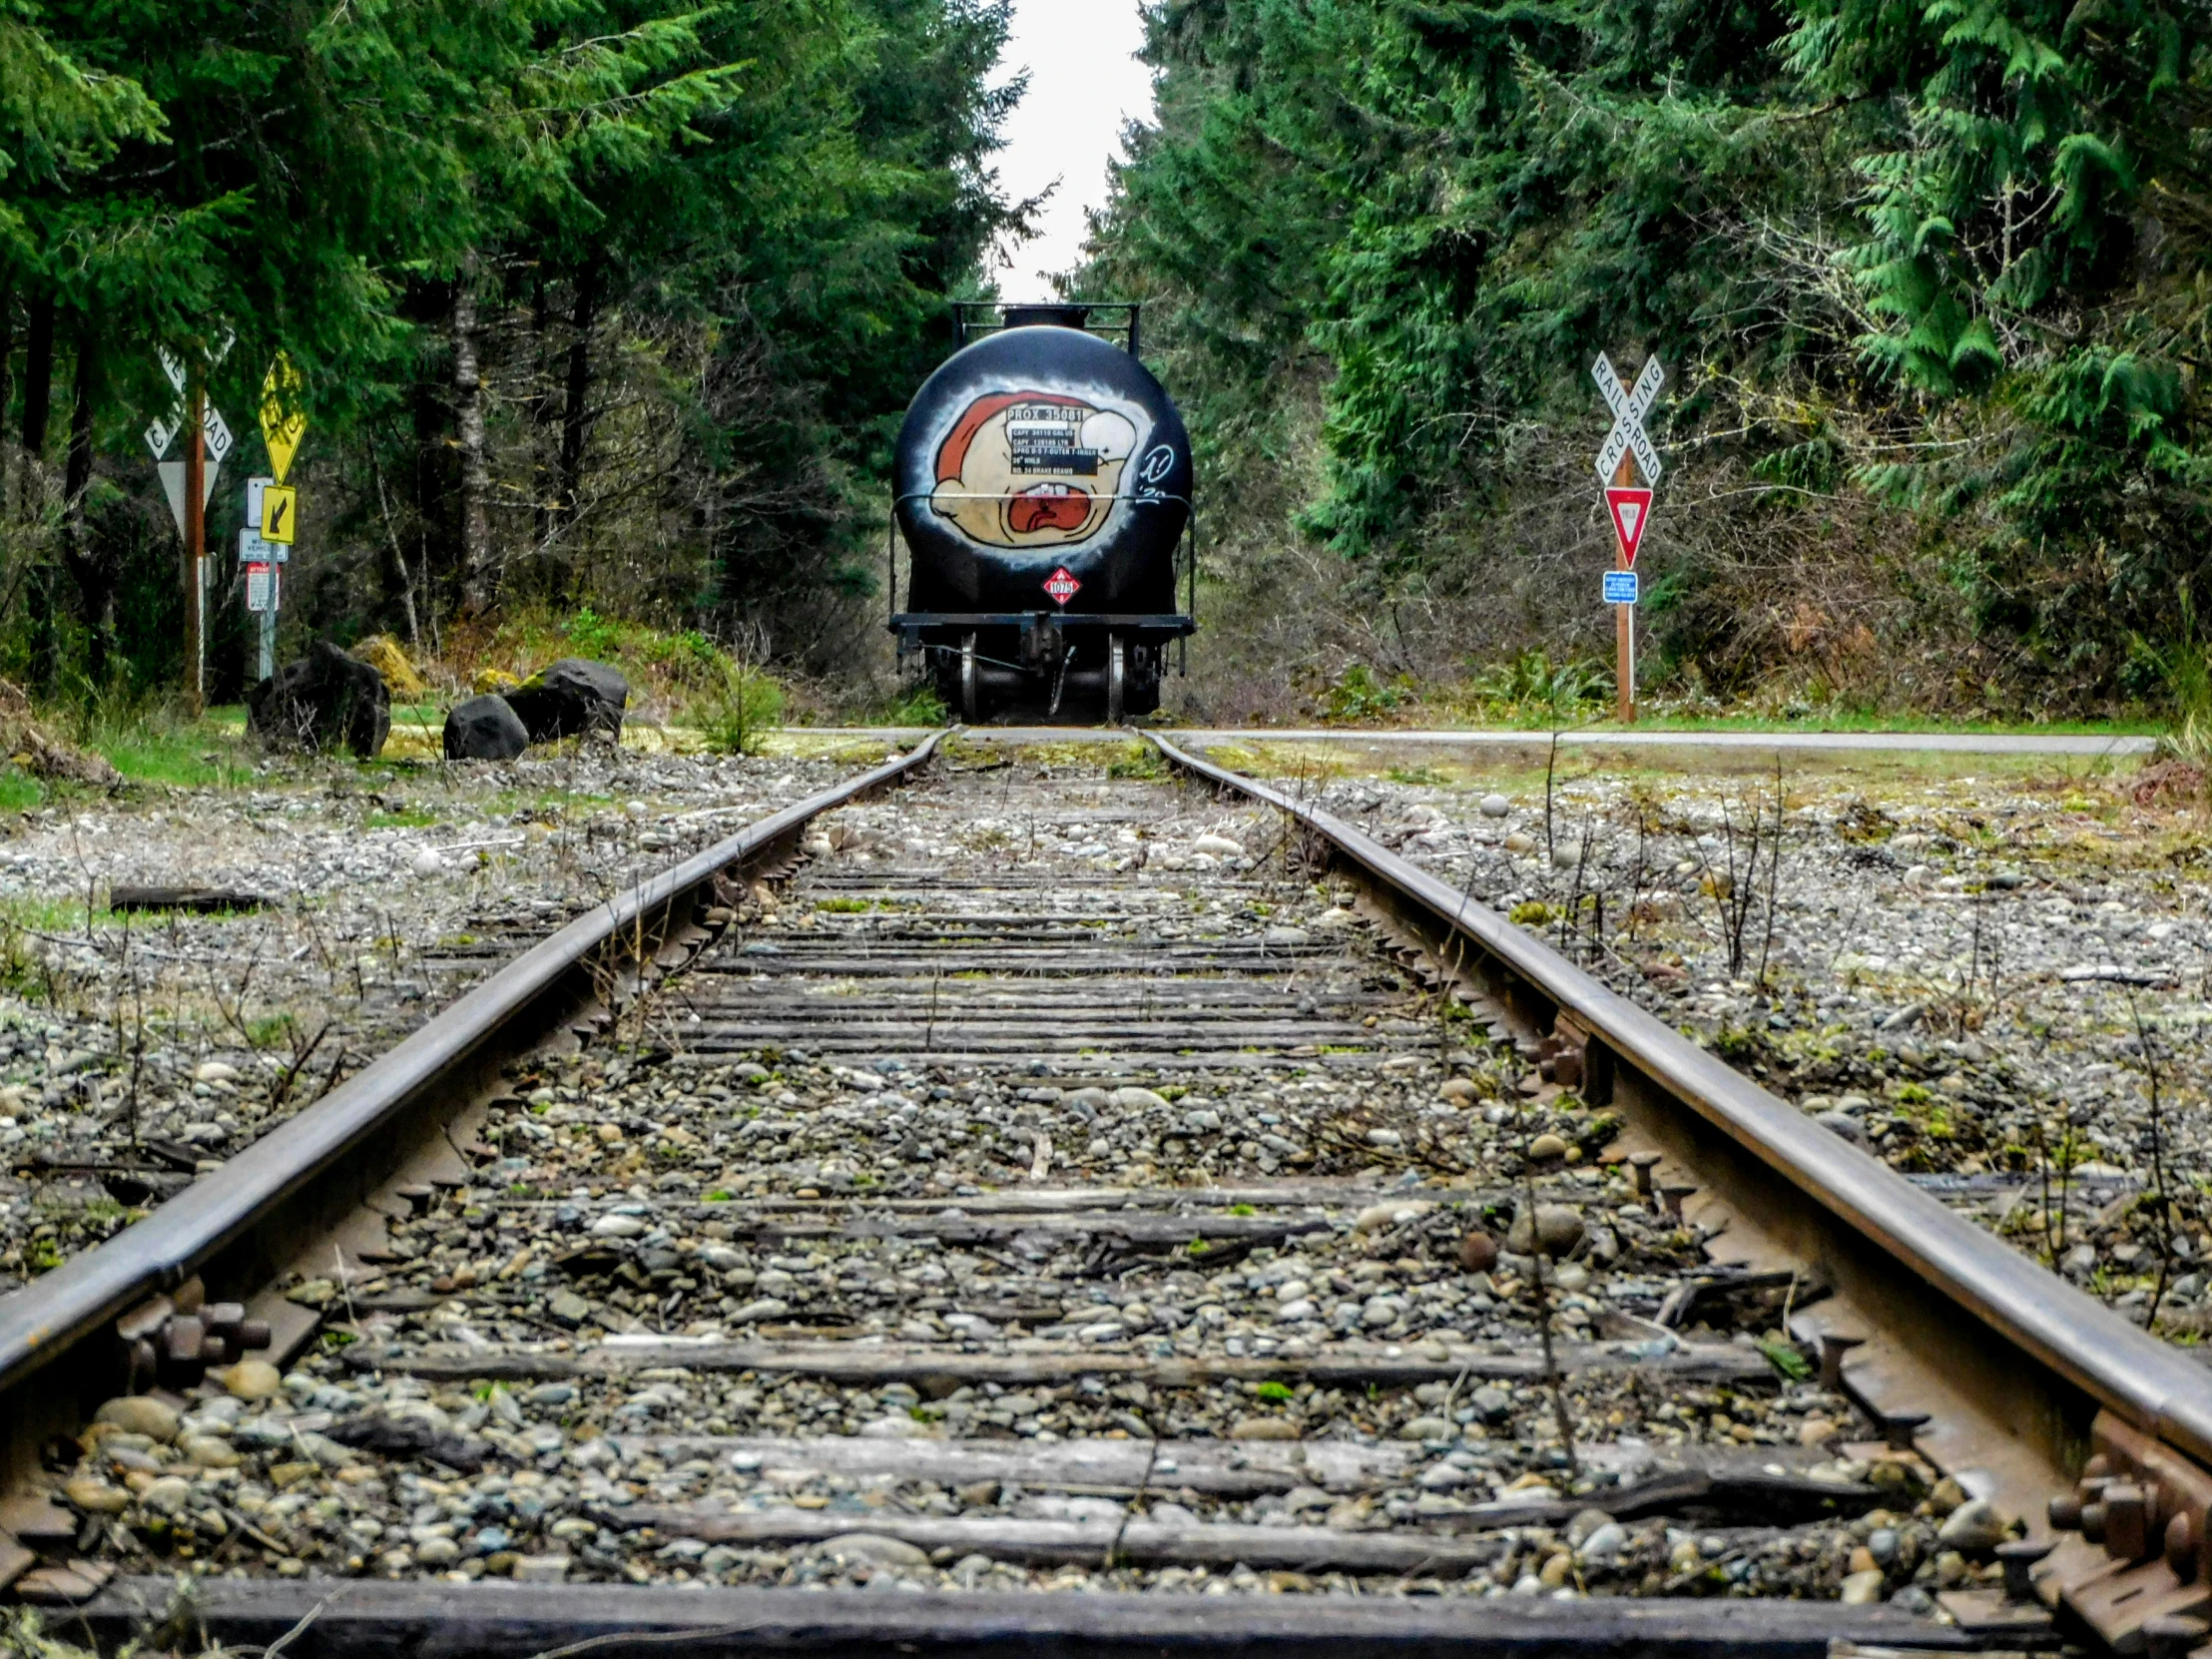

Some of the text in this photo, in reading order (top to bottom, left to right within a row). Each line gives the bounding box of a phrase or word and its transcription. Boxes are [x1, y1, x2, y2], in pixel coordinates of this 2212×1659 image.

[203, 407, 228, 452] OAD
[1008, 409, 1082, 421] PROX 35081
[1595, 359, 1658, 479] RAIL ROAD
[1599, 363, 1661, 477] CROSSING
[1052, 582, 1072, 593] 1075
